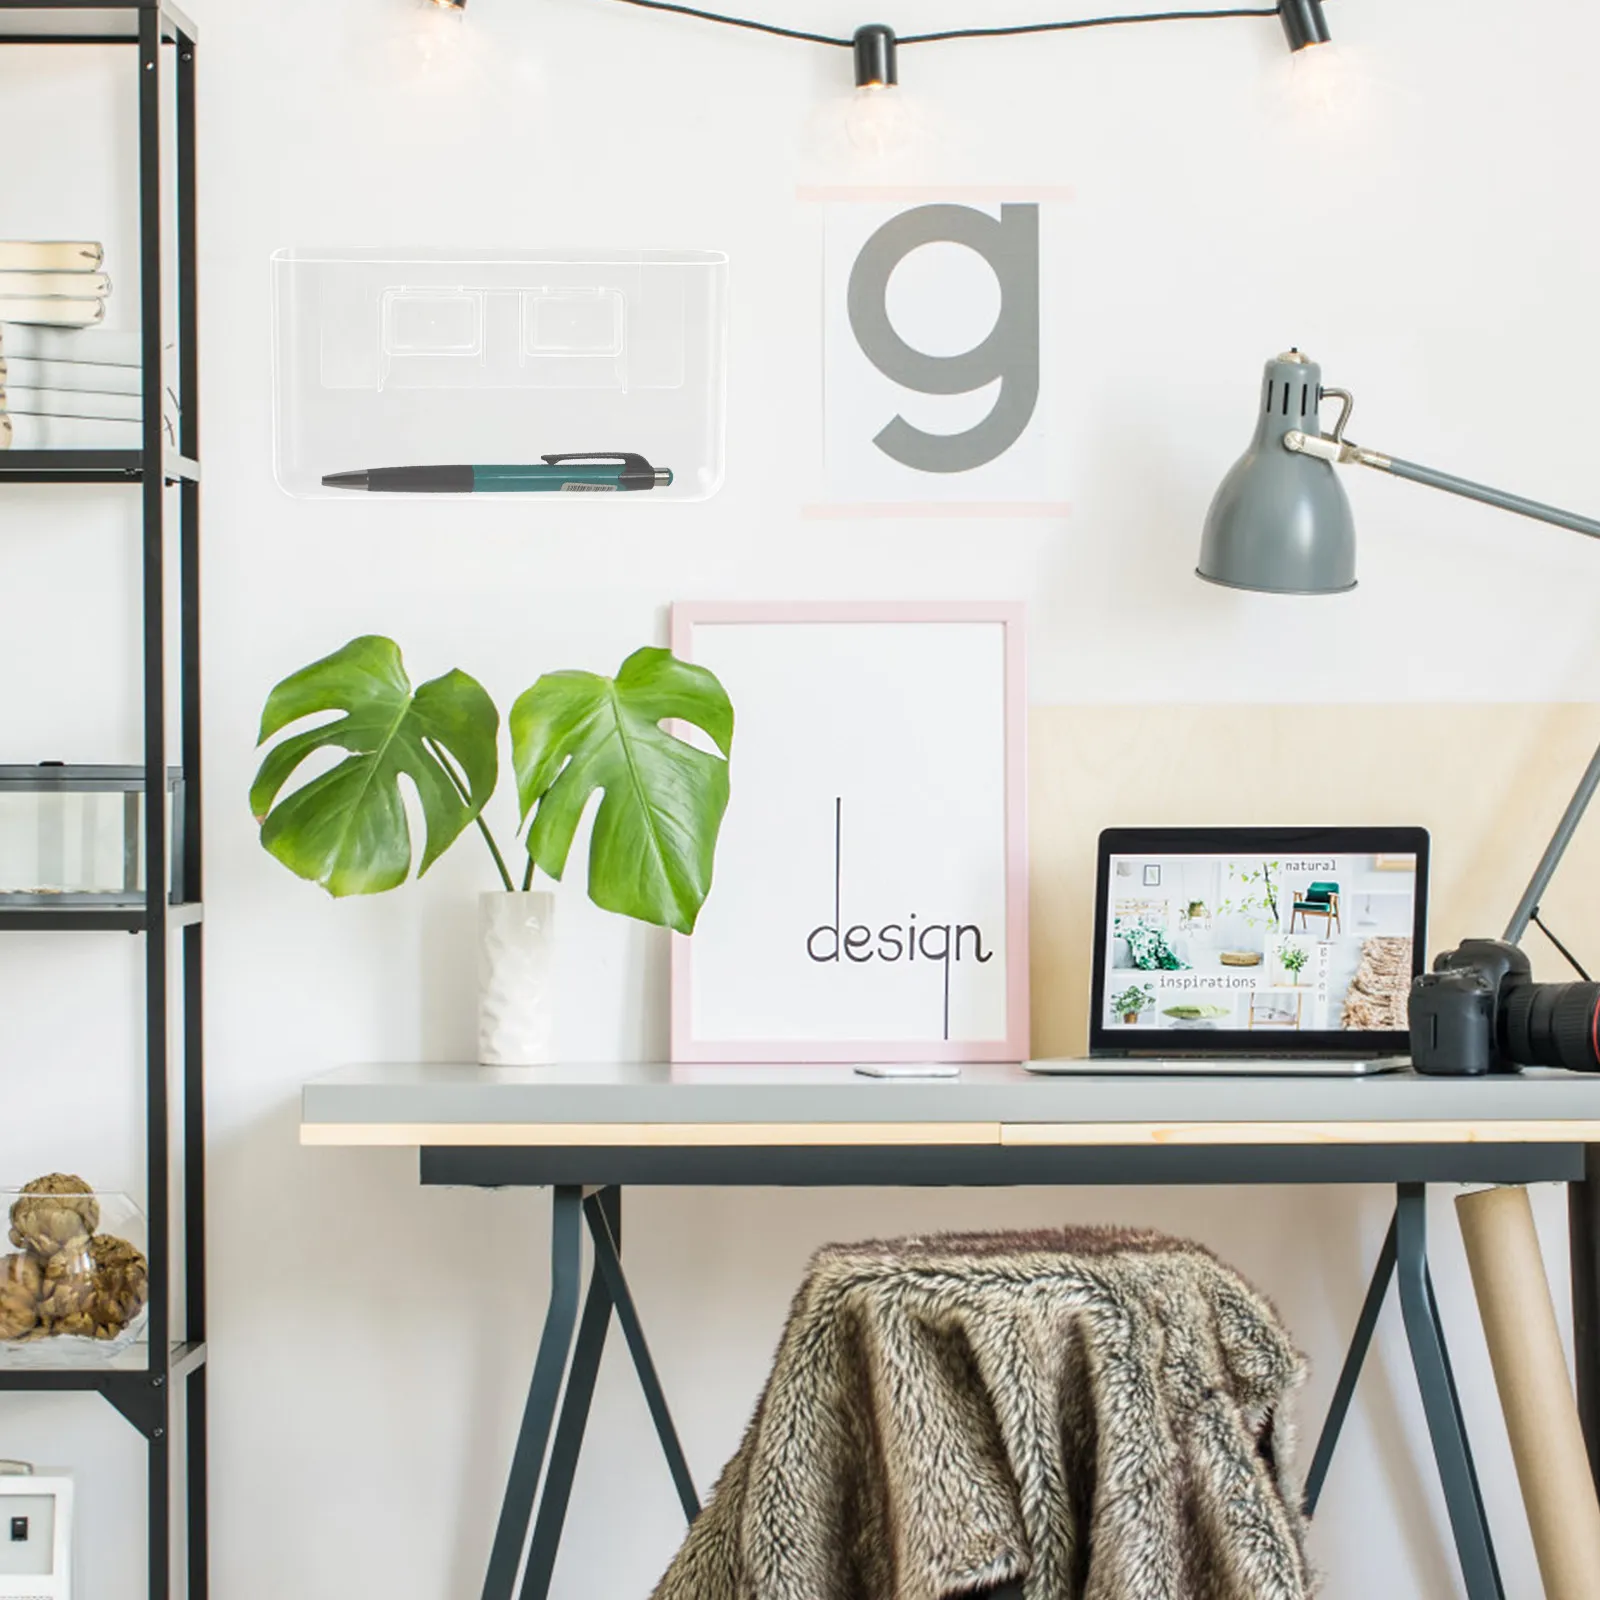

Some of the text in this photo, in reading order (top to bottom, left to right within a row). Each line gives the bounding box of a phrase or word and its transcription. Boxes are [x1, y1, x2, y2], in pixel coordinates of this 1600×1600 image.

[847, 203, 1039, 473] g
[1285, 860, 1336, 871] natural
[1159, 975, 1257, 989] inspirations
